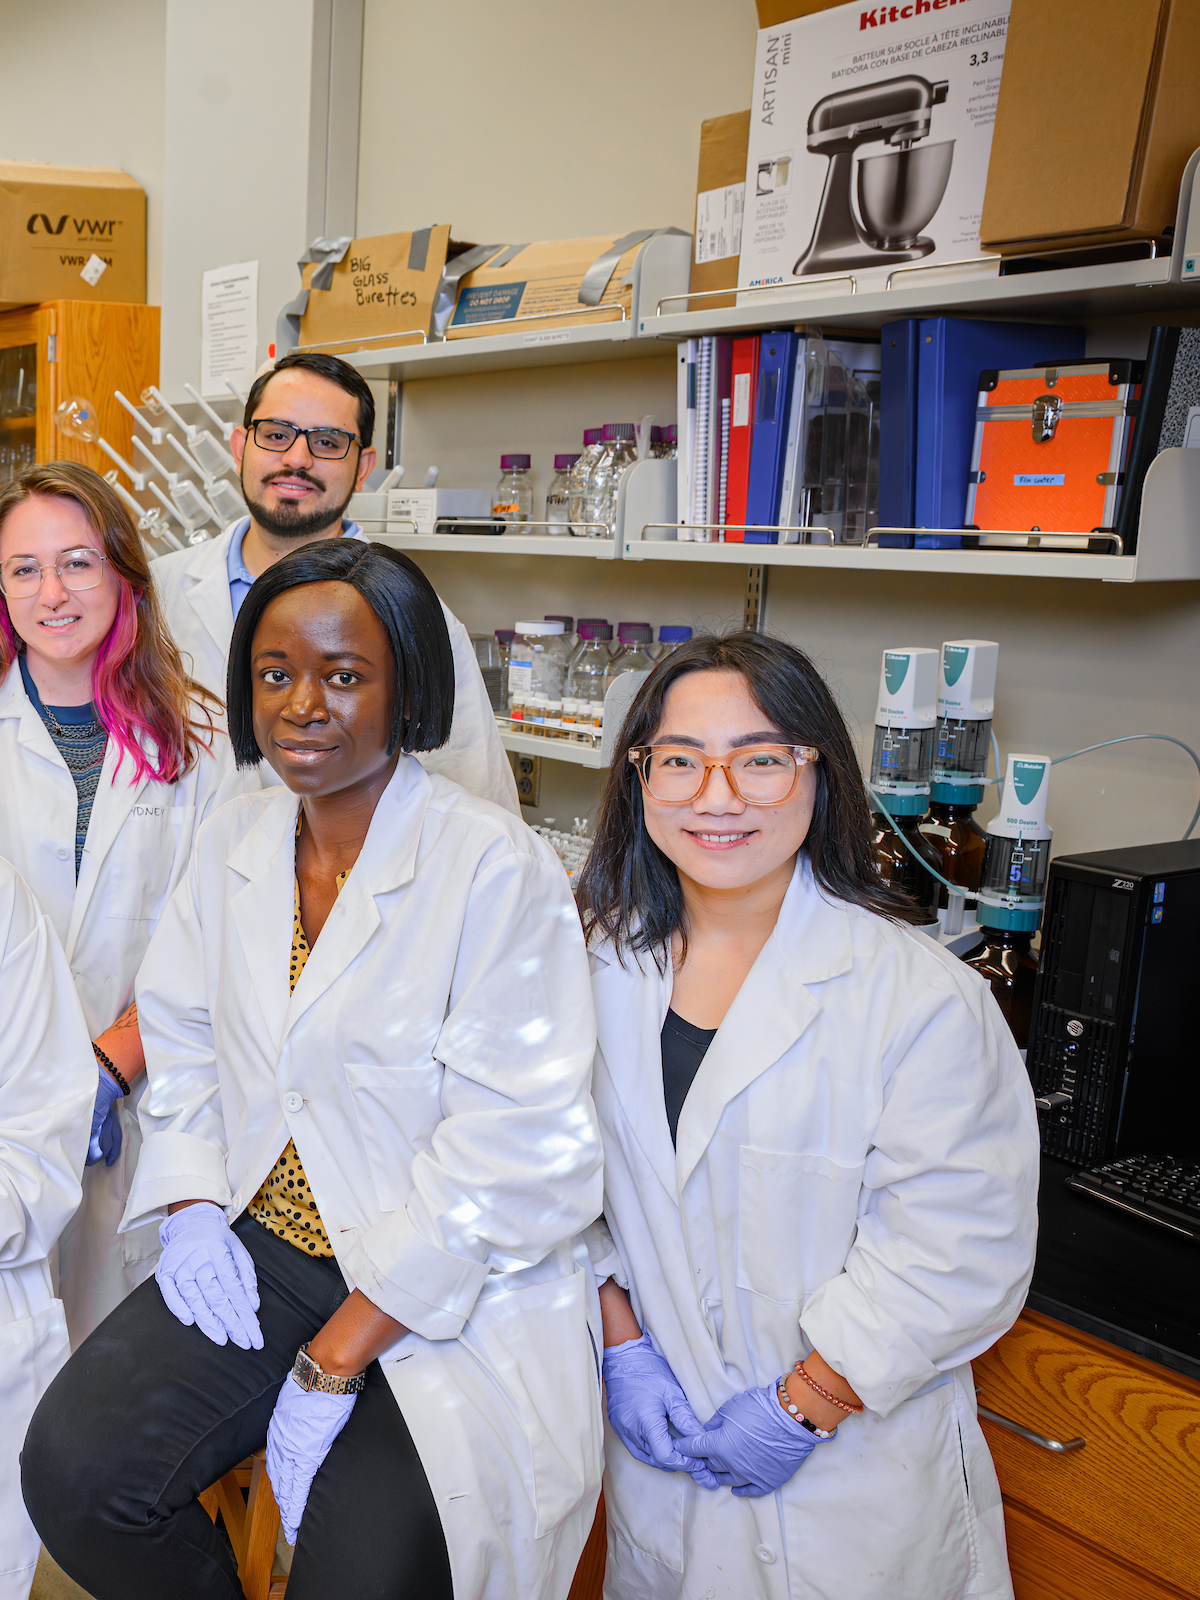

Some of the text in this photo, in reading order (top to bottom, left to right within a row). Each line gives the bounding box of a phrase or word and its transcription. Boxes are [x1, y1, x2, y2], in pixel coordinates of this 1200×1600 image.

[781, 32, 792, 65] mini
[852, 49, 886, 64] BATTEUR
[887, 45, 903, 58] SUR
[904, 37, 930, 53] SOCLE
[940, 27, 960, 41] TÊTE
[831, 64, 869, 79] BATIDORA
[870, 57, 889, 70] CON
[890, 51, 911, 65] BASE
[912, 48, 923, 59] DE
[924, 40, 958, 55] CABEZA
[969, 51, 989, 67] 3,3
[761, 36, 780, 126] ARTISAN
[73, 218, 117, 236] vwr
[350, 255, 371, 273] BIG
[353, 272, 389, 287] GLASS
[356, 284, 417, 307] Burettes
[469, 295, 511, 307] DO NOT DROP
[937, 741, 947, 758] 5
[881, 750, 891, 768] 5
[1009, 864, 1022, 882] 5
[1112, 878, 1135, 889] Z220
